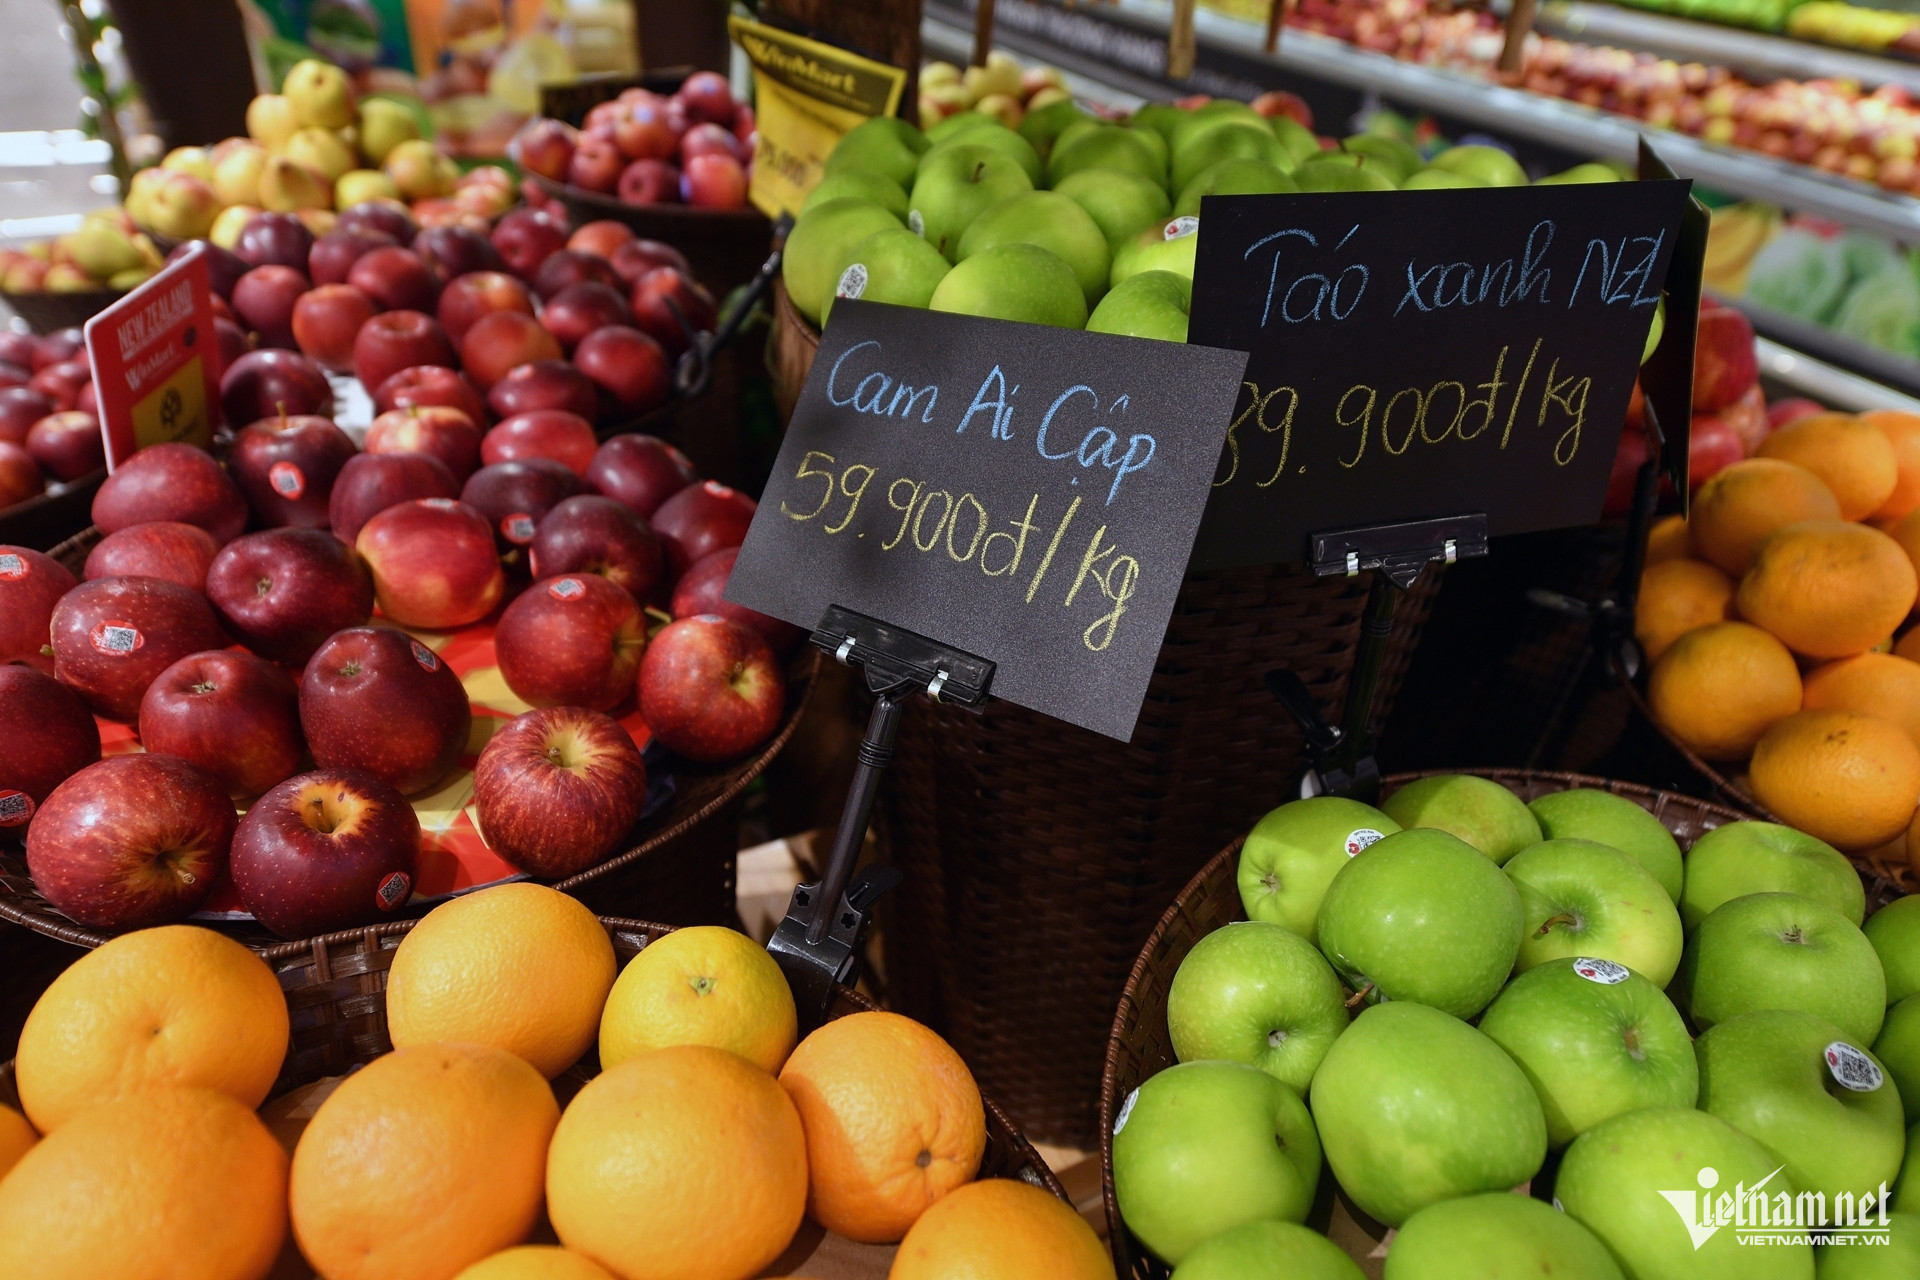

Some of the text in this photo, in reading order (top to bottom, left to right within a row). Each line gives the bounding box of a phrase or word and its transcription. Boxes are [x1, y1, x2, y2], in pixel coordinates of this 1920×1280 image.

[741, 34, 856, 93] WinMart
[1393, 220, 1556, 317] xanh
[117, 278, 194, 355] NEW ZEALAND
[827, 341, 938, 423] Cam
[1036, 384, 1156, 507] Cập
